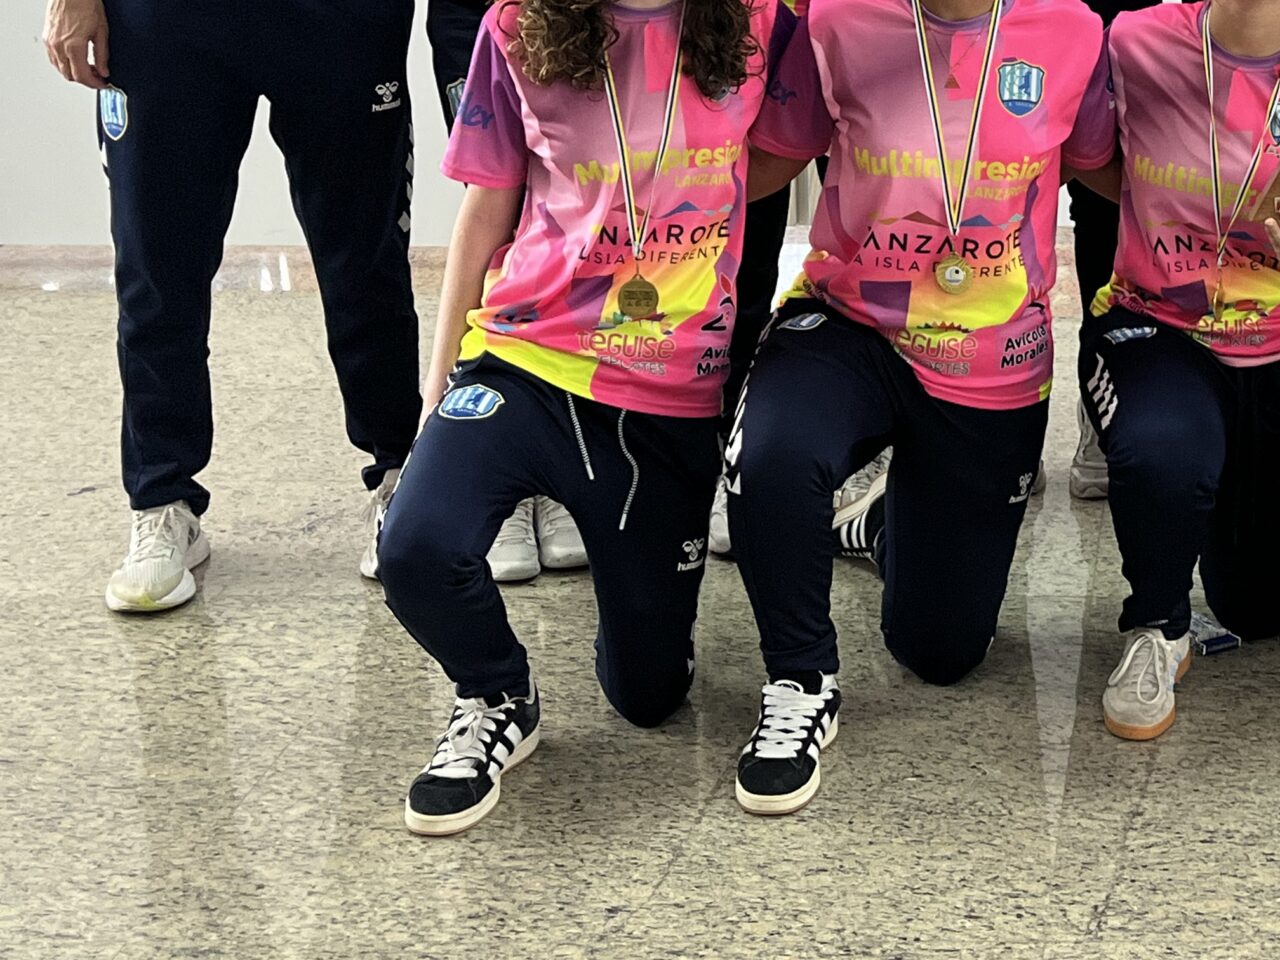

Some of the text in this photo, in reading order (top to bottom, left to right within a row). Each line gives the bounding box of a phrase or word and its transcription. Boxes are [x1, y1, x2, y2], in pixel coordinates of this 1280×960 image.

[875, 256, 920, 273] ISLA
[1166, 260, 1209, 274] ISLA
[1001, 341, 1049, 369] Morales
